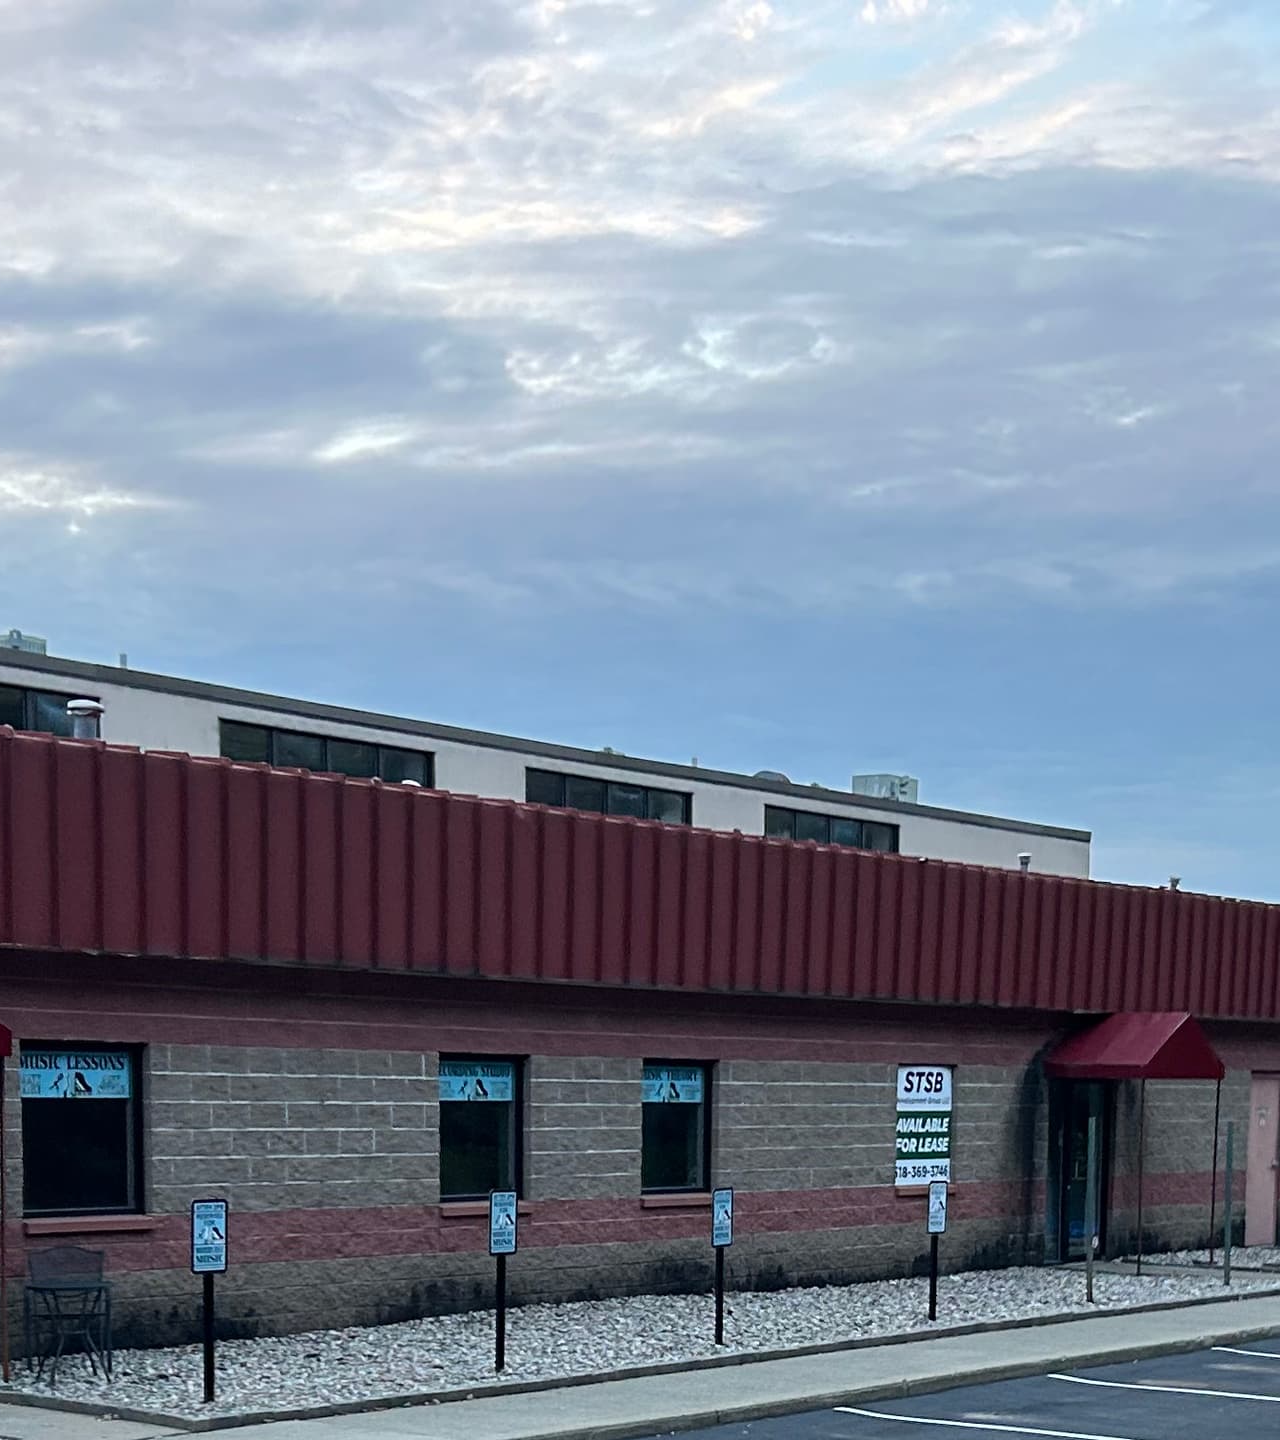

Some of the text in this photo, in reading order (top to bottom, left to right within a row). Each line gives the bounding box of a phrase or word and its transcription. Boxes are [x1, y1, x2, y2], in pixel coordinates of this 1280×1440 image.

[19, 1055, 124, 1070] MUSIC LESSONS
[904, 1071, 944, 1094] STSB
[896, 1117, 950, 1133] AVAILABLE
[896, 1137, 950, 1153] FOR LEASE
